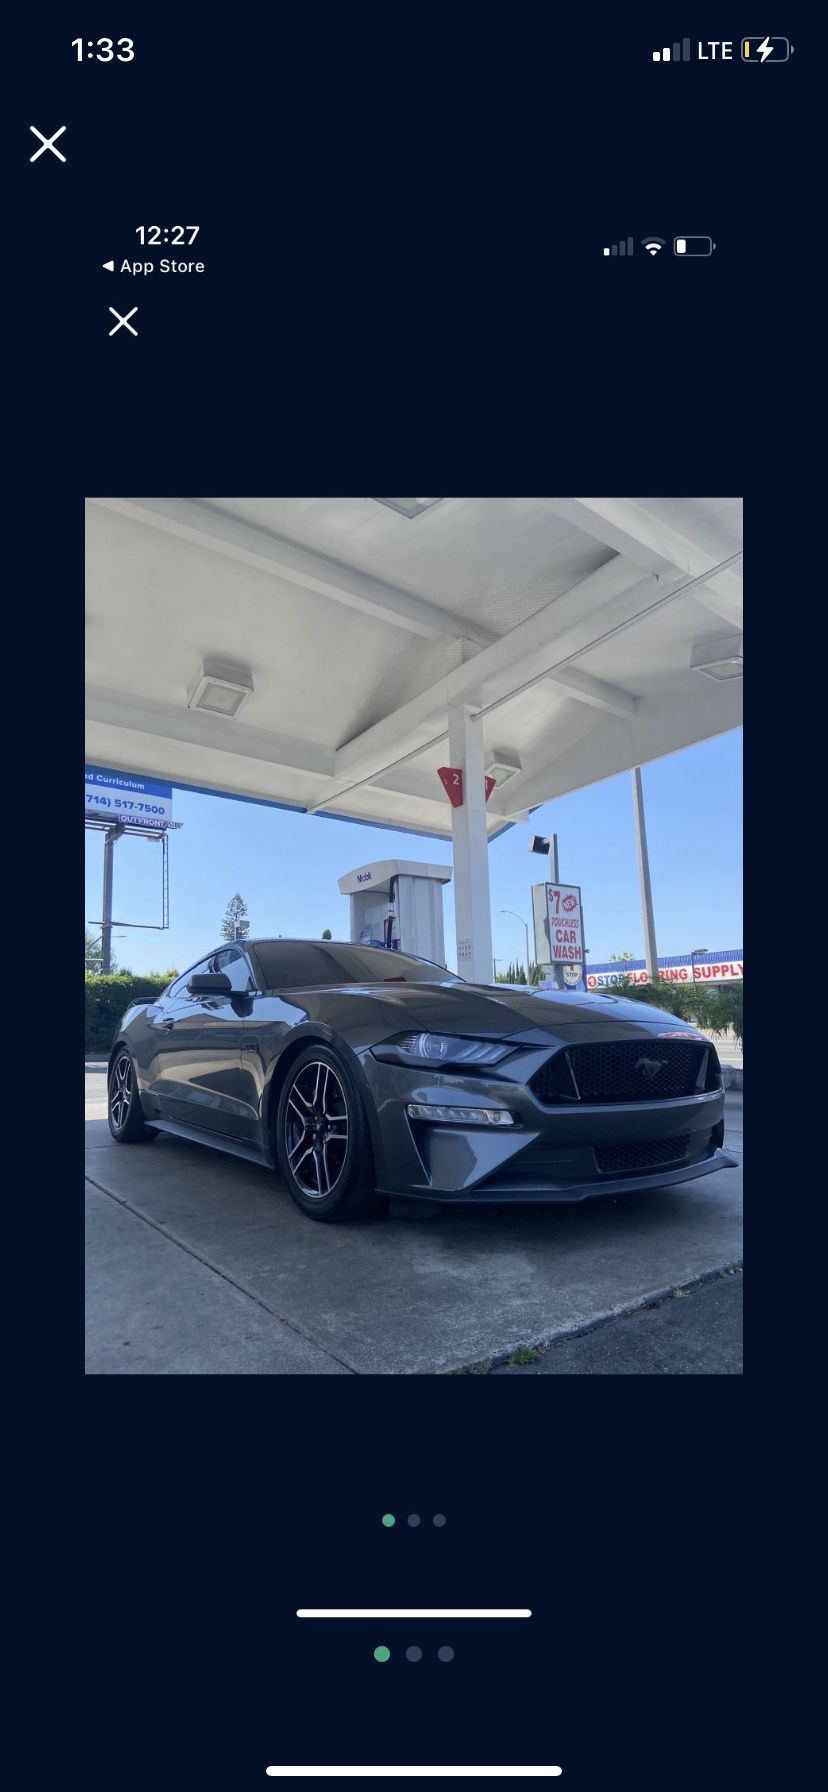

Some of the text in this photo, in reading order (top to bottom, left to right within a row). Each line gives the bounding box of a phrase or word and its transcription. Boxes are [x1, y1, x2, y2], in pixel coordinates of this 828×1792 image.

[96, 774, 145, 789] Curriculum
[452, 773, 460, 785] 2
[114, 798, 165, 815] 517-7500
[357, 871, 371, 883] Mobil
[563, 898, 577, 909] NEW
[551, 917, 579, 929] TOUCHLESS
[555, 930, 576, 944] CAR
[552, 945, 582, 960] WASH
[627, 968, 688, 983] FLORING
